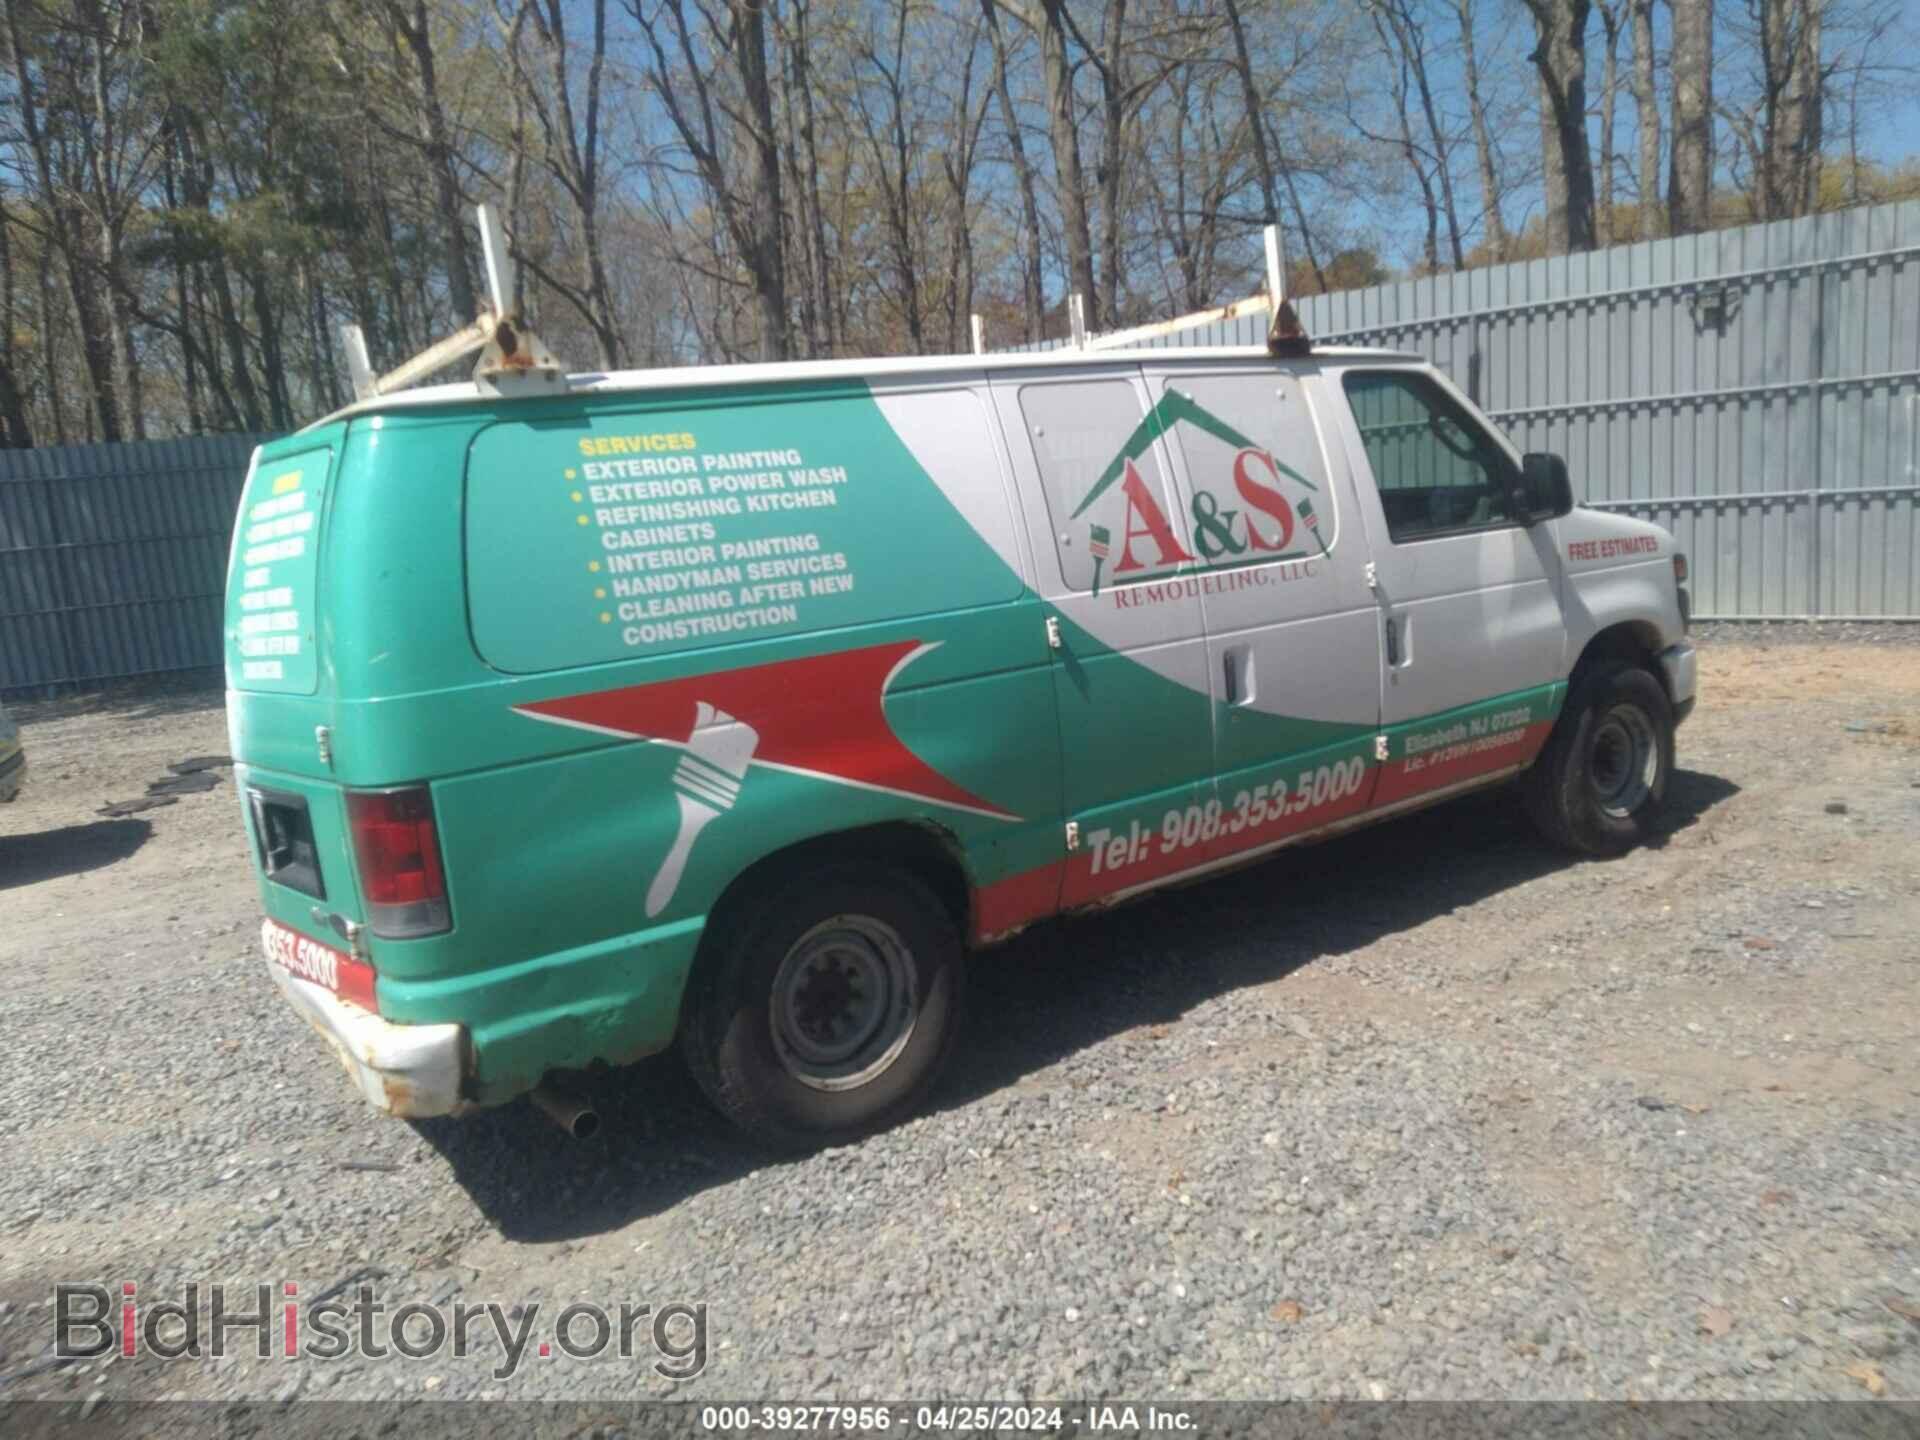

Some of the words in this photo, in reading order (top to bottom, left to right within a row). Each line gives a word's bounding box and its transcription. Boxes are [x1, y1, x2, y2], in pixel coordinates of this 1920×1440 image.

[579, 433, 696, 456] SERVICES
[583, 456, 698, 481] EXTERIOR
[702, 449, 801, 472] PAINTING
[589, 478, 703, 503] EXTERIOR
[708, 472, 785, 493] POWER
[788, 466, 848, 485] WASH
[596, 498, 742, 526] REFINISHING
[747, 489, 837, 512] KITCHEN
[602, 522, 716, 549] CABINETS
[607, 546, 717, 573] INTERIOR
[721, 534, 820, 560] PAINTING
[1568, 541, 1599, 561] FREE
[1600, 534, 1657, 558] ESTIMATES
[612, 566, 742, 597] HANDYMAN
[747, 553, 847, 581] SERVICES
[1114, 567, 1276, 608] REMODELING,
[1281, 561, 1318, 584] LLC
[618, 590, 734, 622] CLEANING
[739, 580, 806, 606] AFTER
[810, 574, 854, 596] NEW
[623, 604, 797, 646] CONSTRUCTION
[1470, 716, 1489, 736] NJ
[1087, 820, 1151, 875] Tel:
[1160, 755, 1365, 853] 908.353.5000
